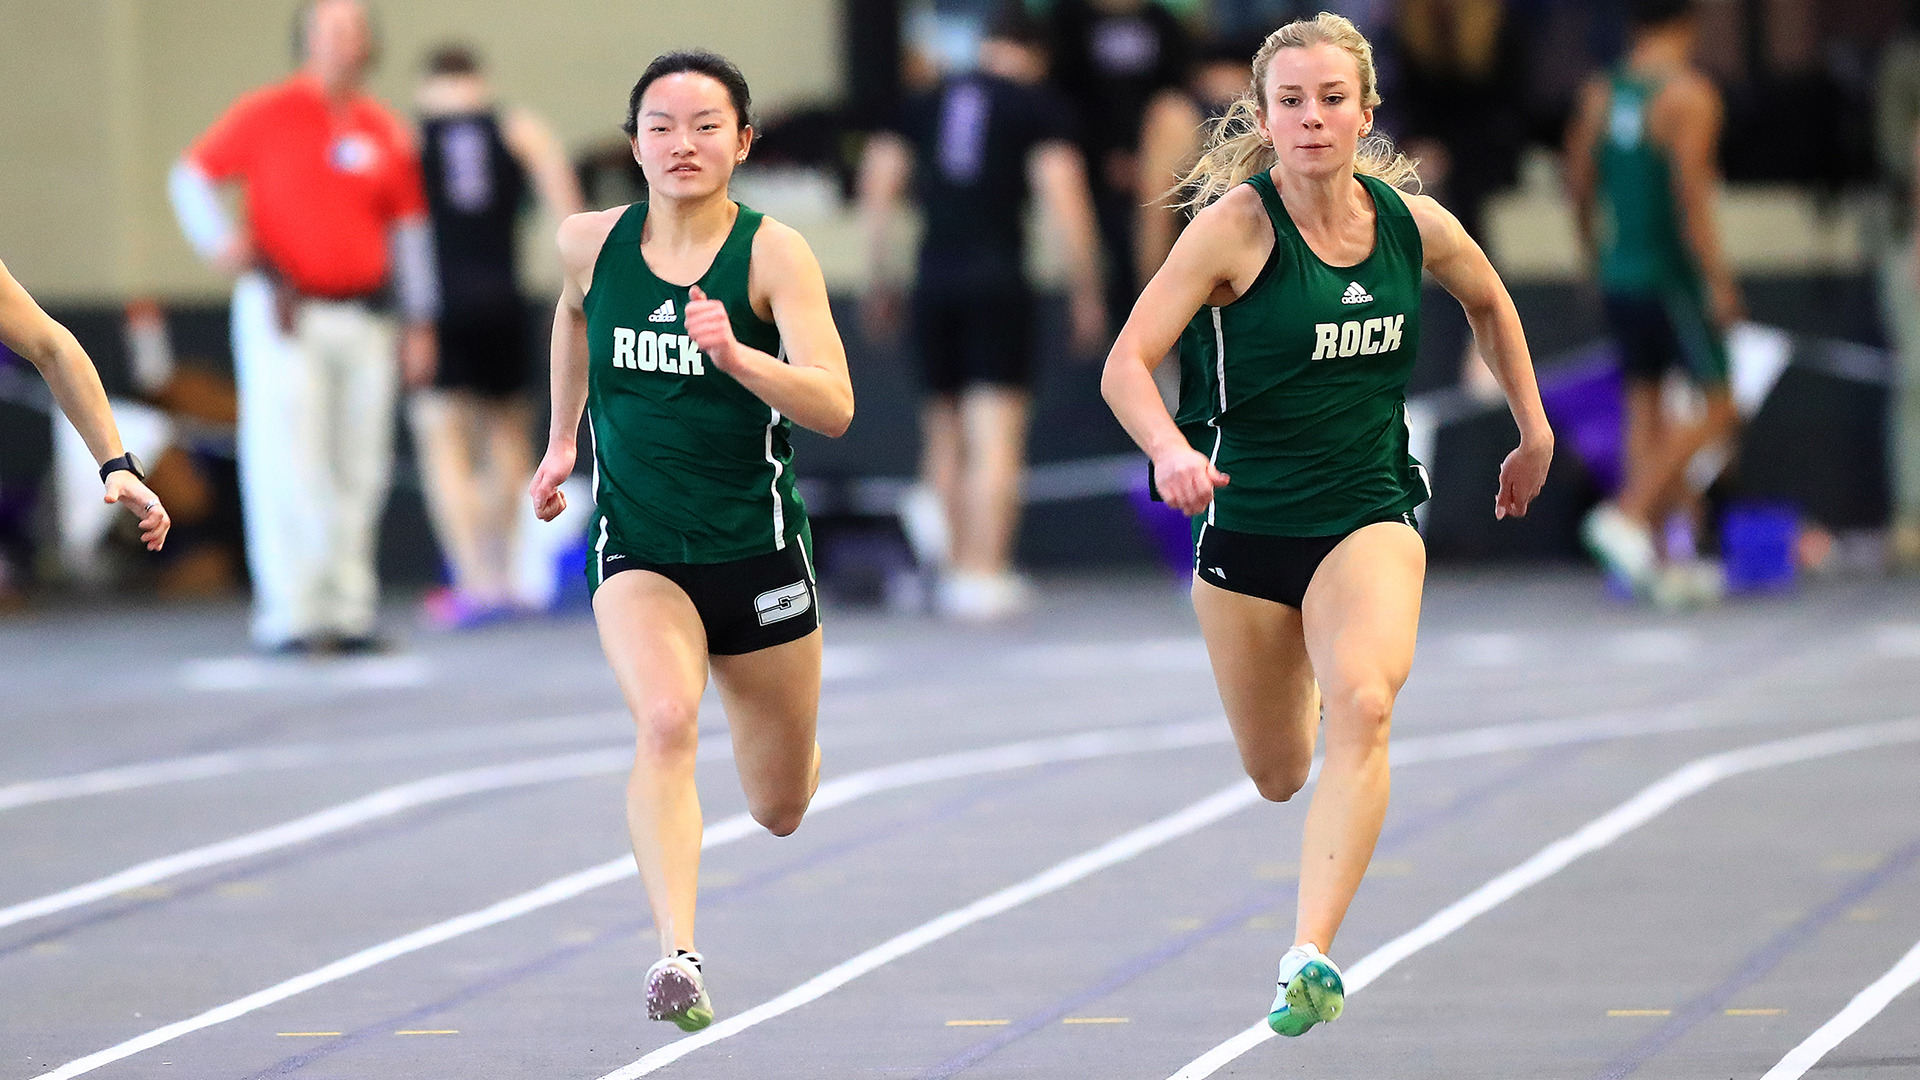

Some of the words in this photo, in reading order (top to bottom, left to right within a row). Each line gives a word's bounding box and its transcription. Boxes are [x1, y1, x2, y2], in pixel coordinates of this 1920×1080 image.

[1341, 294, 1374, 304] adidas
[648, 313, 678, 323] adidas
[612, 327, 705, 376] ROCK
[1311, 314, 1405, 361] ROCK
